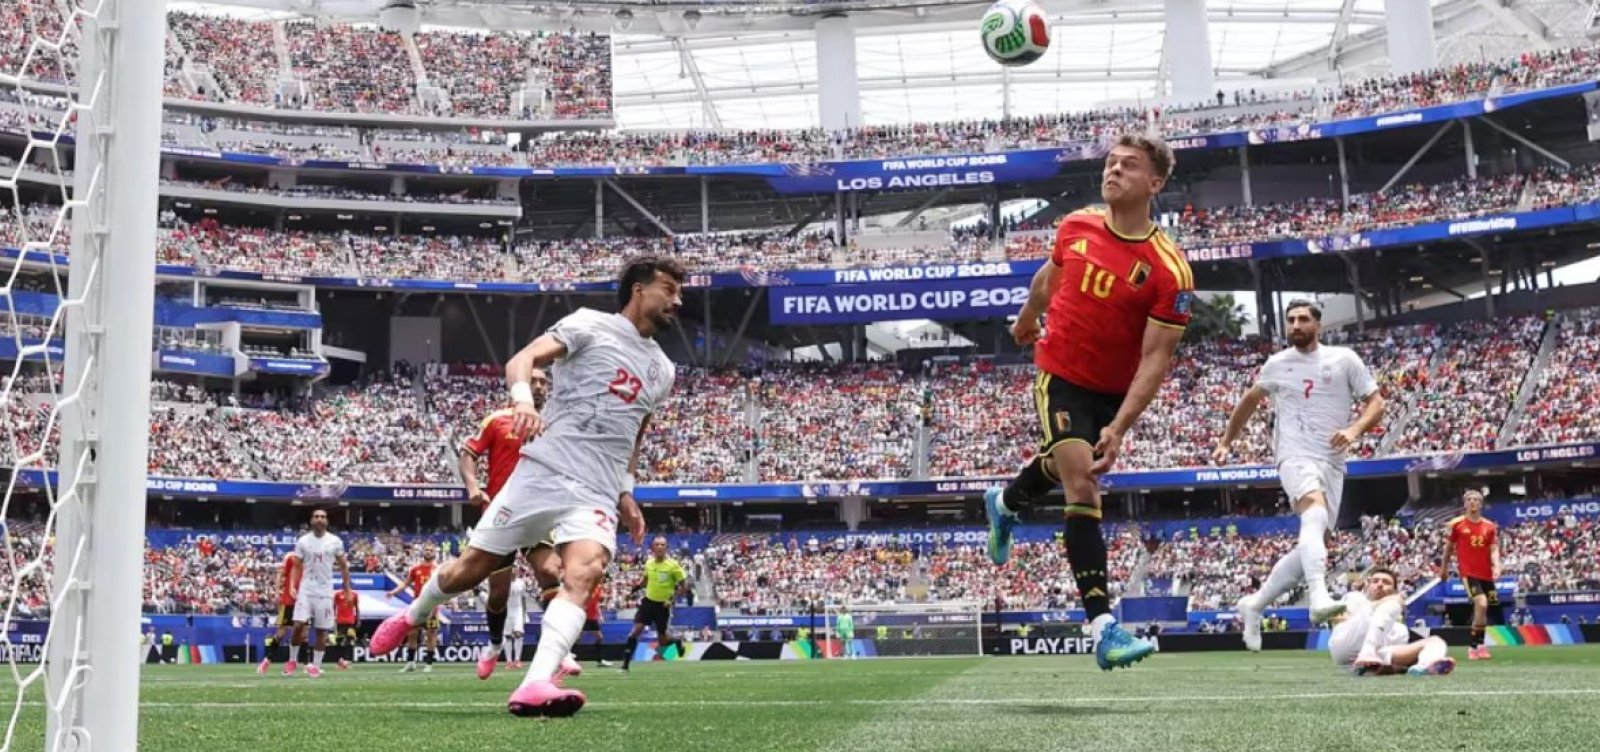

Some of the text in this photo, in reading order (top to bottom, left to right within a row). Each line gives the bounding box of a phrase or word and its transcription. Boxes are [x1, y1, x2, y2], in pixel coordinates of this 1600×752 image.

[882, 155, 1008, 171] FIFA WORLD CUP 2026
[837, 171, 995, 190] LOS ANGELES
[835, 263, 1012, 283] FIFA WORLD CUP 2026
[1080, 263, 1116, 299] 10
[783, 286, 1029, 314] FIFA WORLD CUP 202
[608, 367, 642, 404] 23
[1303, 379, 1314, 399] 7
[1517, 446, 1594, 462] LOS ANGELES
[1196, 471, 1219, 482] FIFA
[1220, 469, 1258, 480] WORLD
[165, 480, 183, 490] CUP
[393, 488, 464, 498] LOS ANGELES
[936, 482, 958, 492] LOS
[1516, 505, 1553, 518] LOS
[953, 531, 989, 543] 202
[1470, 535, 1485, 547] 22
